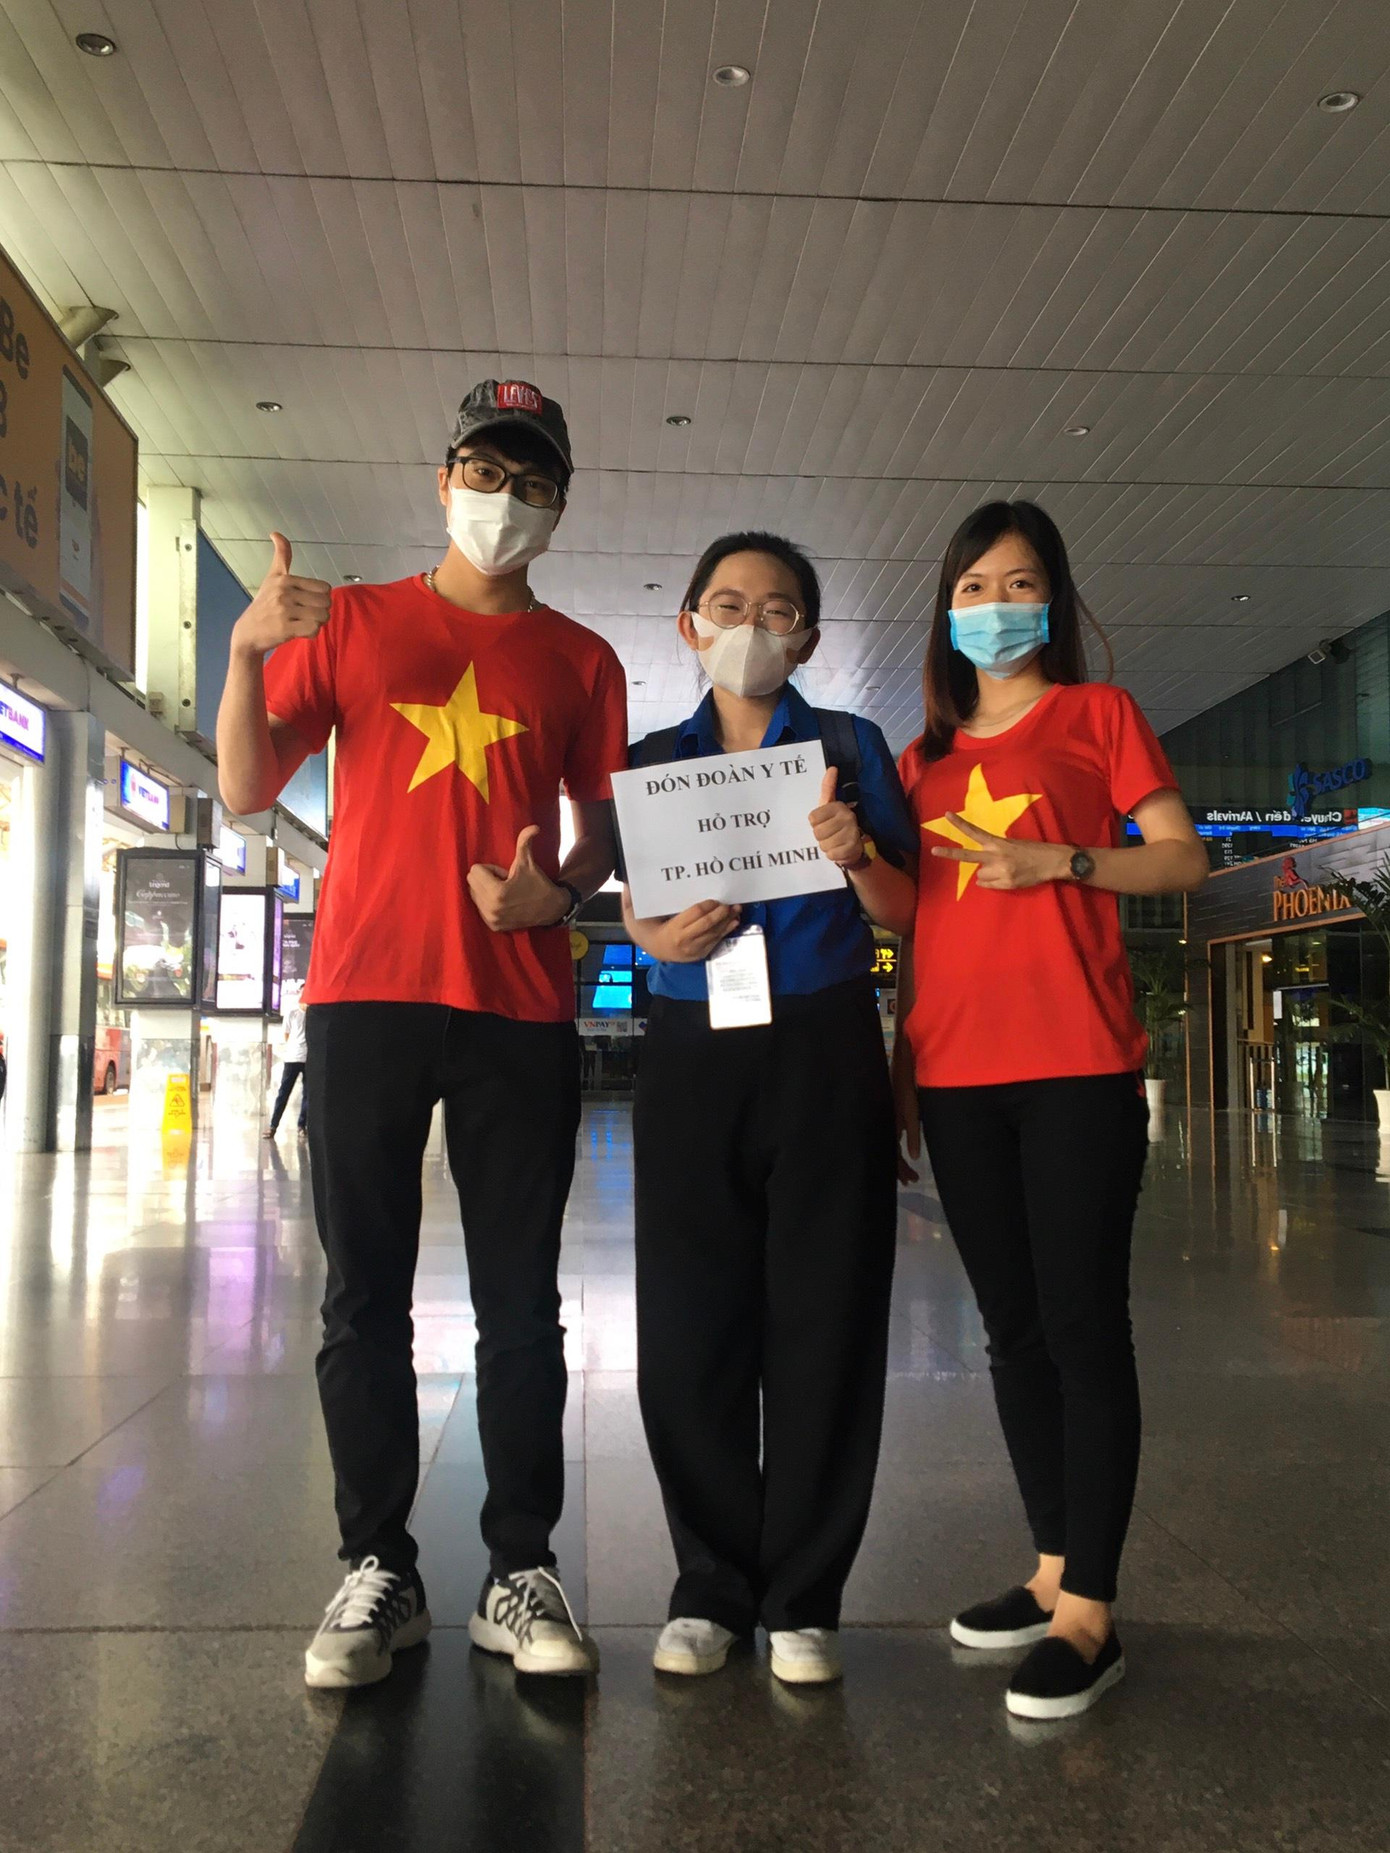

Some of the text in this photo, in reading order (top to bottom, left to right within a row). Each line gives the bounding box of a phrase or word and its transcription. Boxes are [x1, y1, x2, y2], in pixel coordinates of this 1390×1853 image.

[646, 754, 808, 796] ĐÓN ĐOÀN Y TẾ
[1313, 757, 1366, 795] SASCO
[730, 809, 771, 828] TRỢ
[661, 846, 820, 882] TP. HỒ CHÍ MINH
